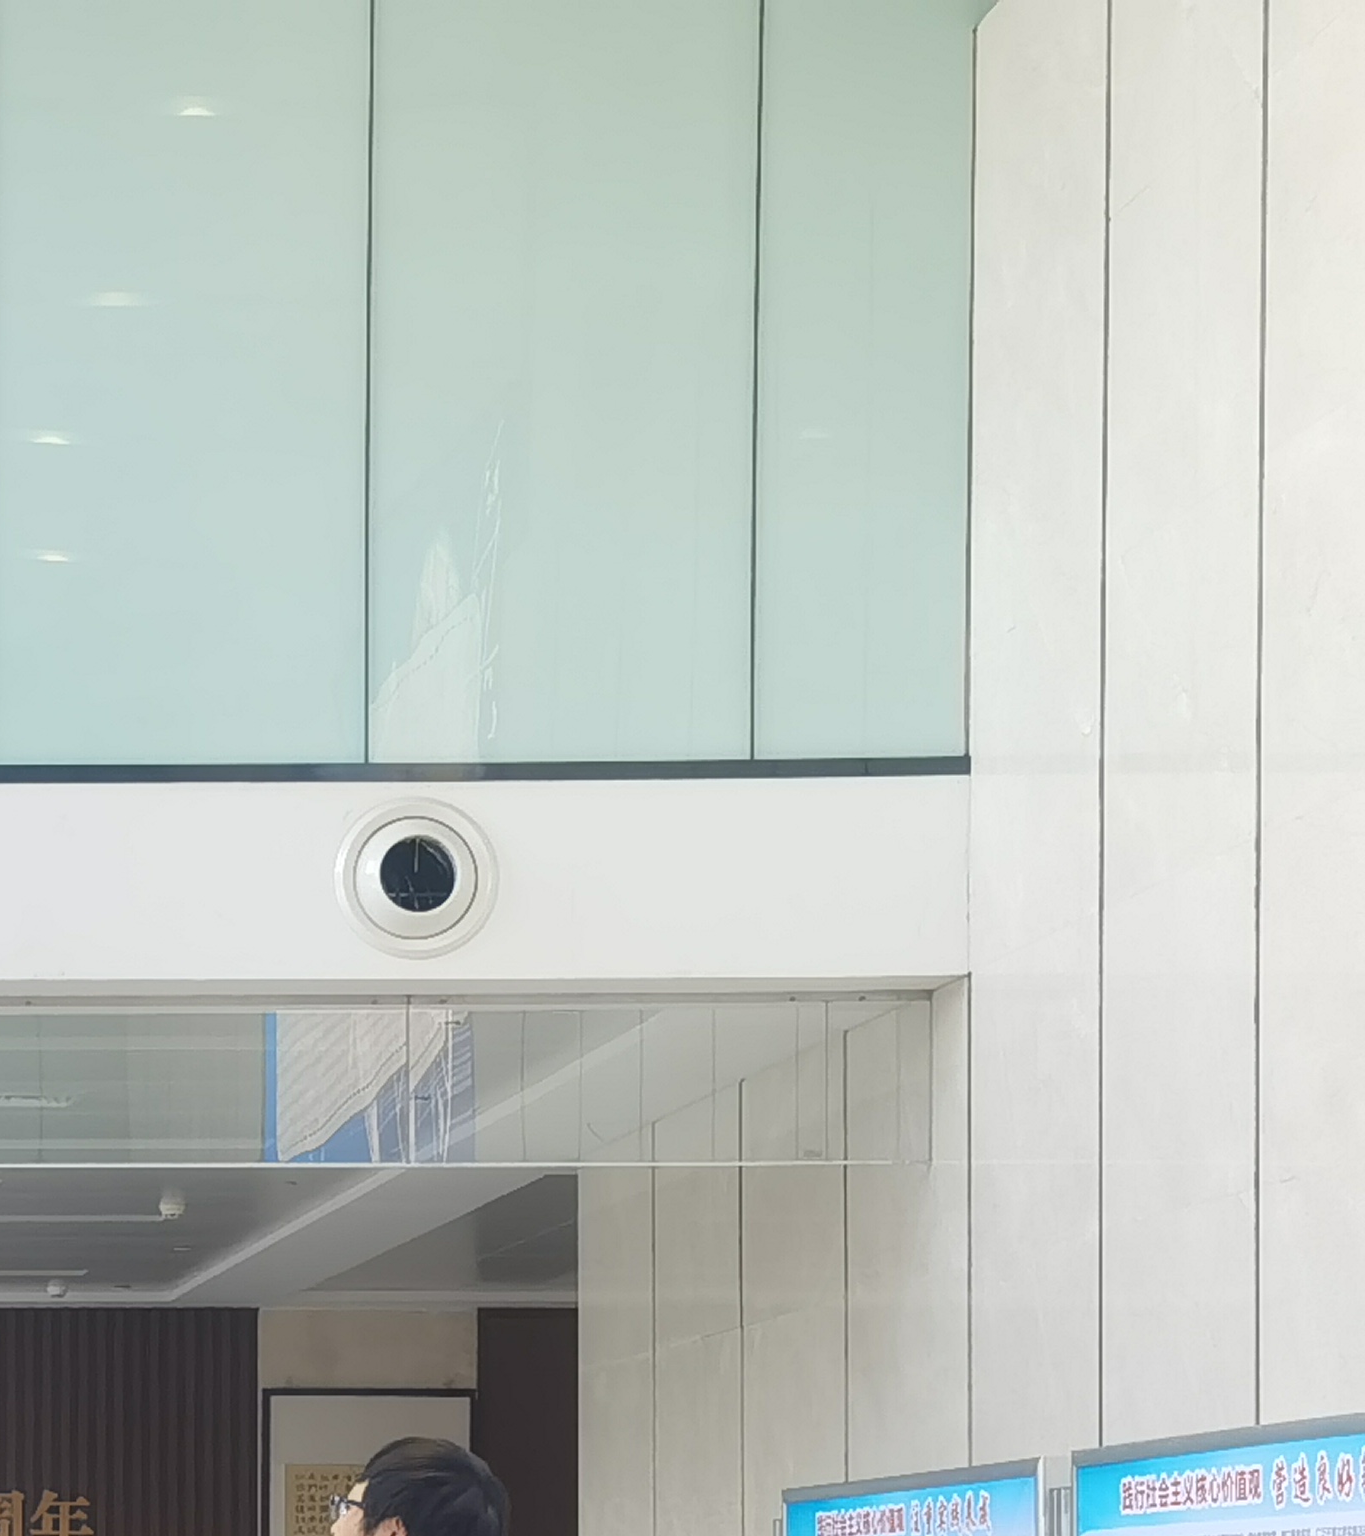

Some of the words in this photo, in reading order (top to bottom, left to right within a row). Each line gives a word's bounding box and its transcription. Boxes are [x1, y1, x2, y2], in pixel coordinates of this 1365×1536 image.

[1121, 1468, 1262, 1512] 践行社会主义核心价值观
[1272, 1450, 1365, 1506] 营造良好
